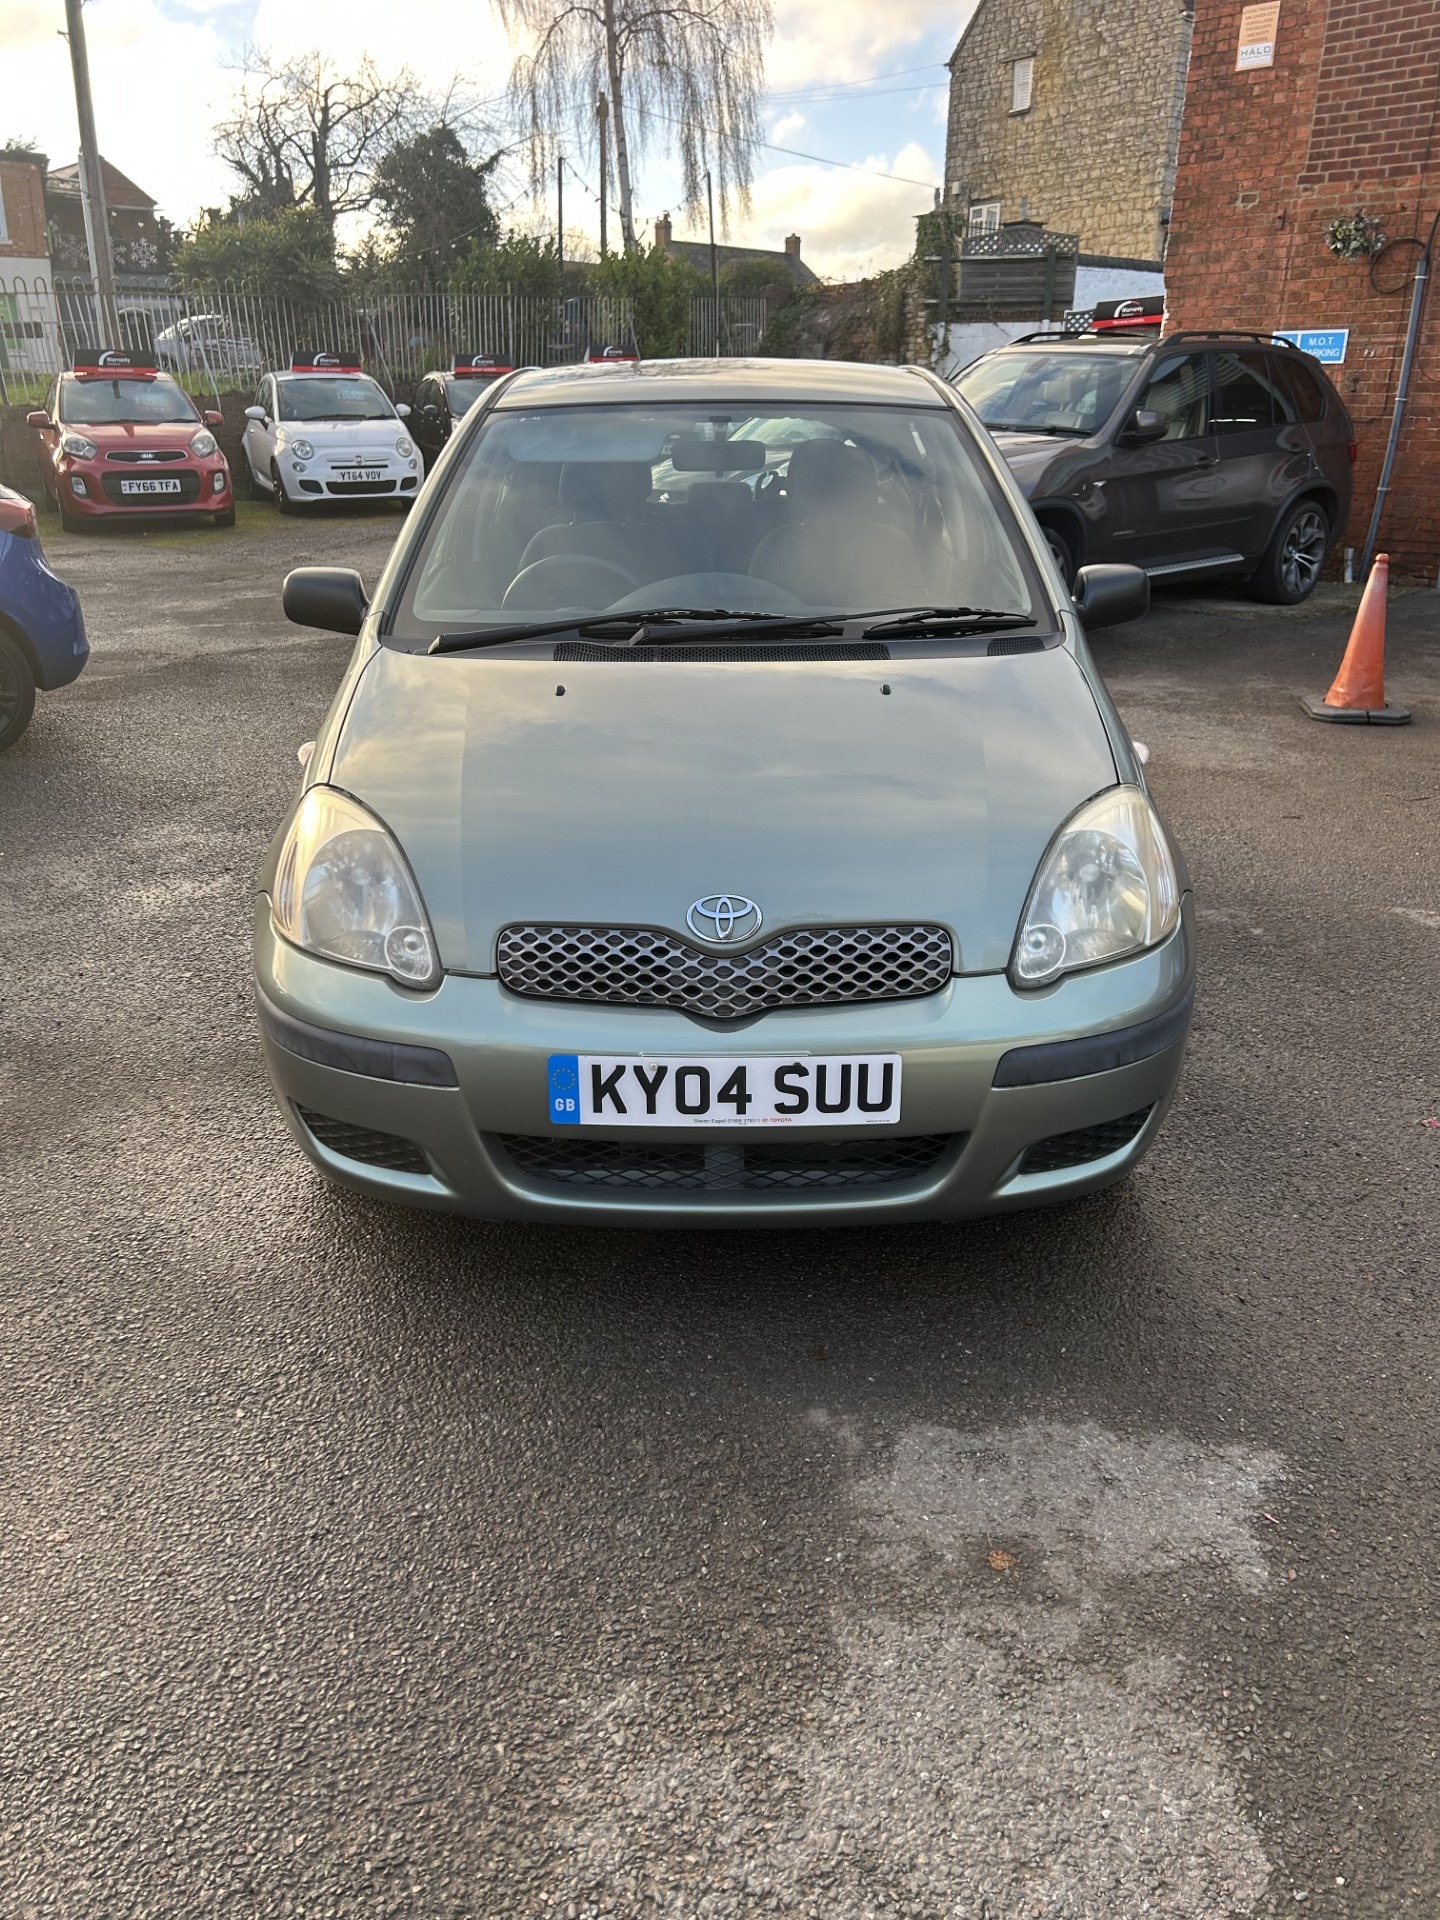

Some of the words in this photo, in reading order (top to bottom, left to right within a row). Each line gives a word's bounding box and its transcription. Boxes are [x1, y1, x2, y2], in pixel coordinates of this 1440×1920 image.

[1240, 45, 1271, 57] HALO
[1308, 336, 1335, 346] M.O.T.
[340, 471, 363, 480] YT64
[128, 481, 156, 492] FY66
[158, 480, 179, 491] TFA
[591, 1064, 752, 1115] KY04
[774, 1062, 894, 1115] SUU
[554, 1098, 575, 1112] GB
